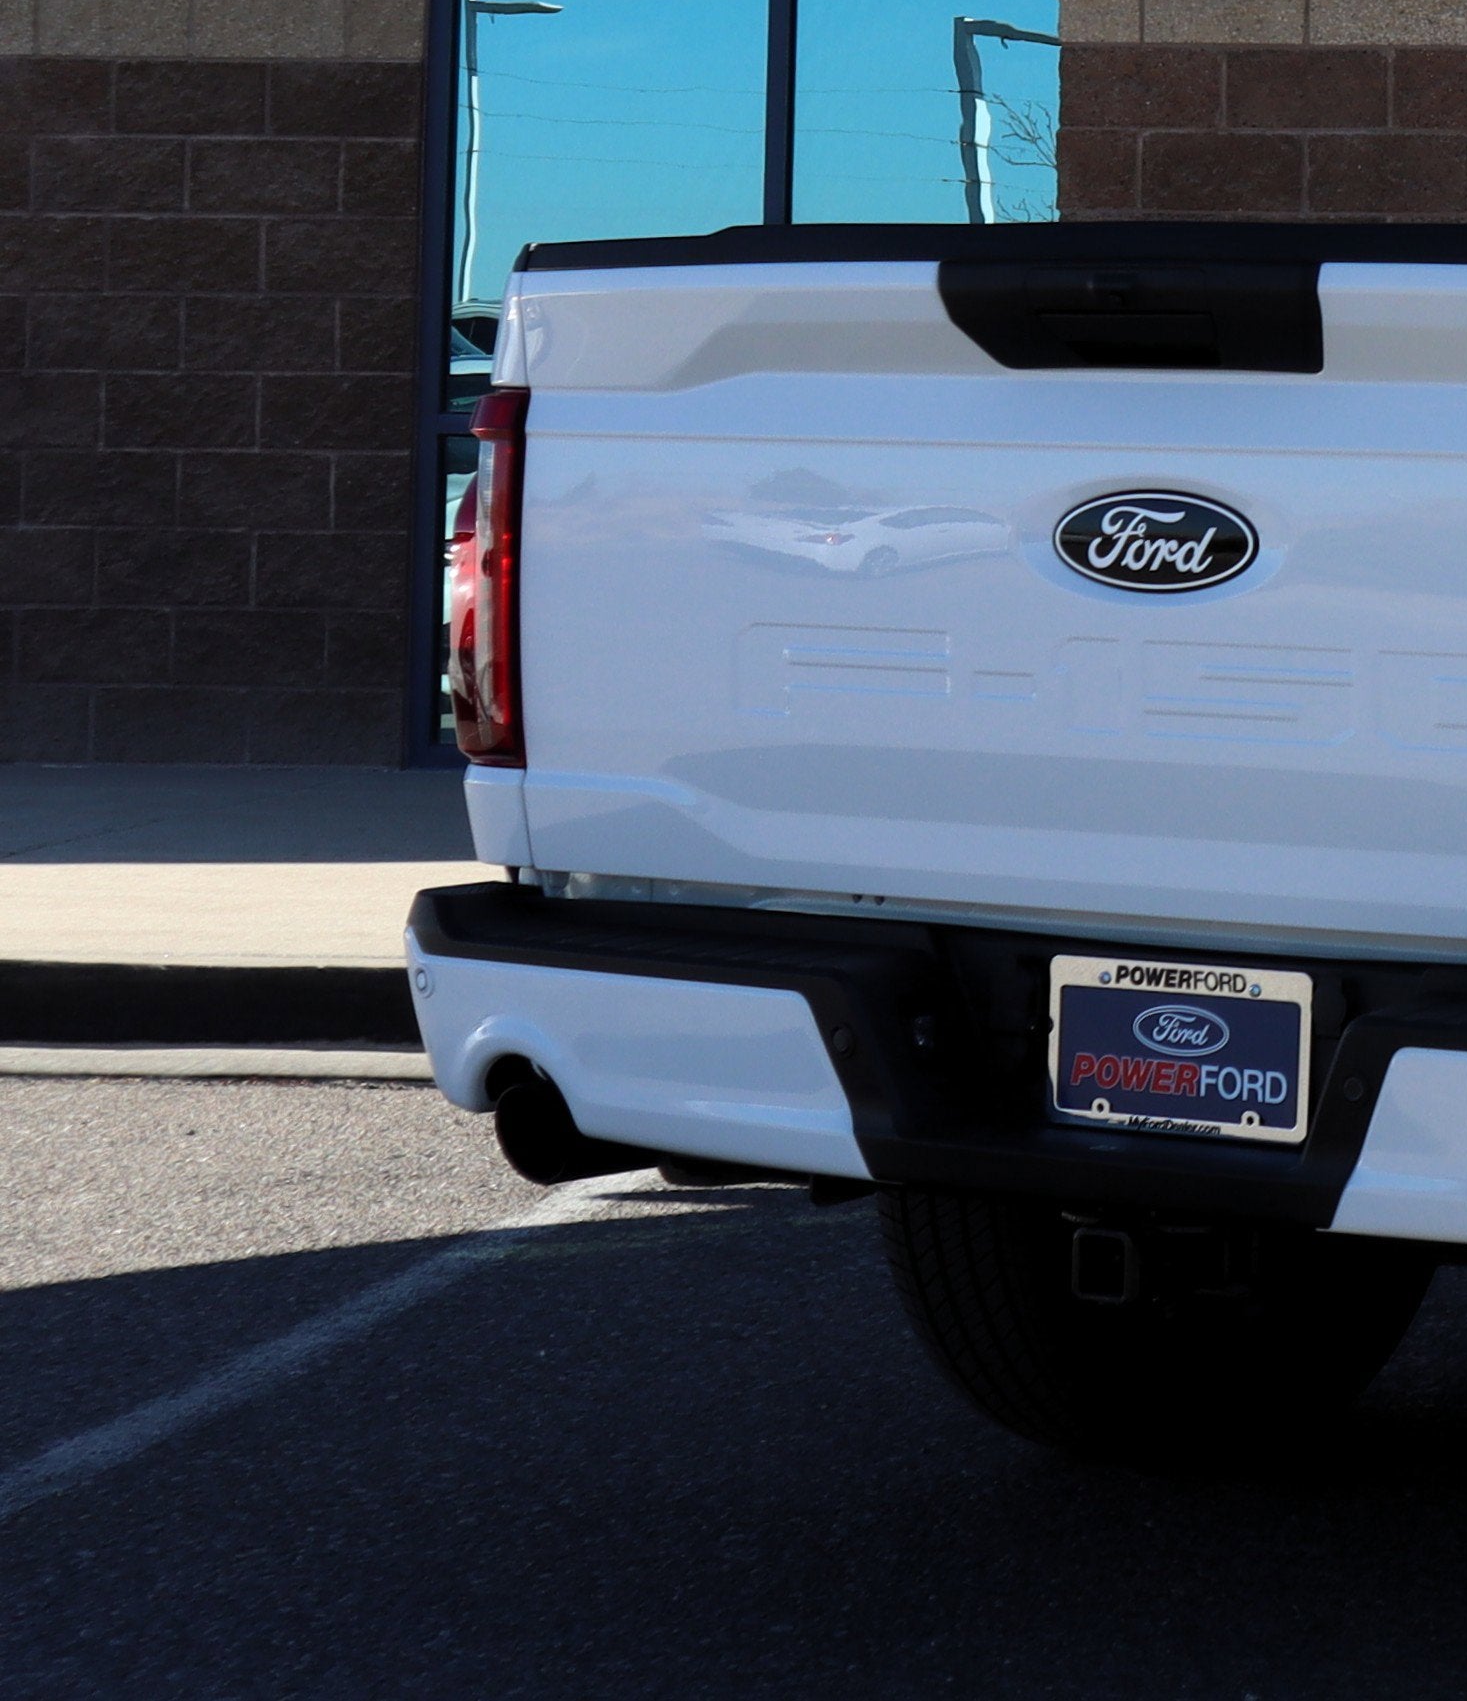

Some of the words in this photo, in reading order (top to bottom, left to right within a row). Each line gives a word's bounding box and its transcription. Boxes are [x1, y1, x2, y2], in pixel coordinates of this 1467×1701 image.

[1087, 505, 1220, 575] Ford
[1115, 965, 1247, 993] POWERFORD
[1152, 1012, 1211, 1047] Ford
[1070, 1052, 1288, 1104] POWERFORD
